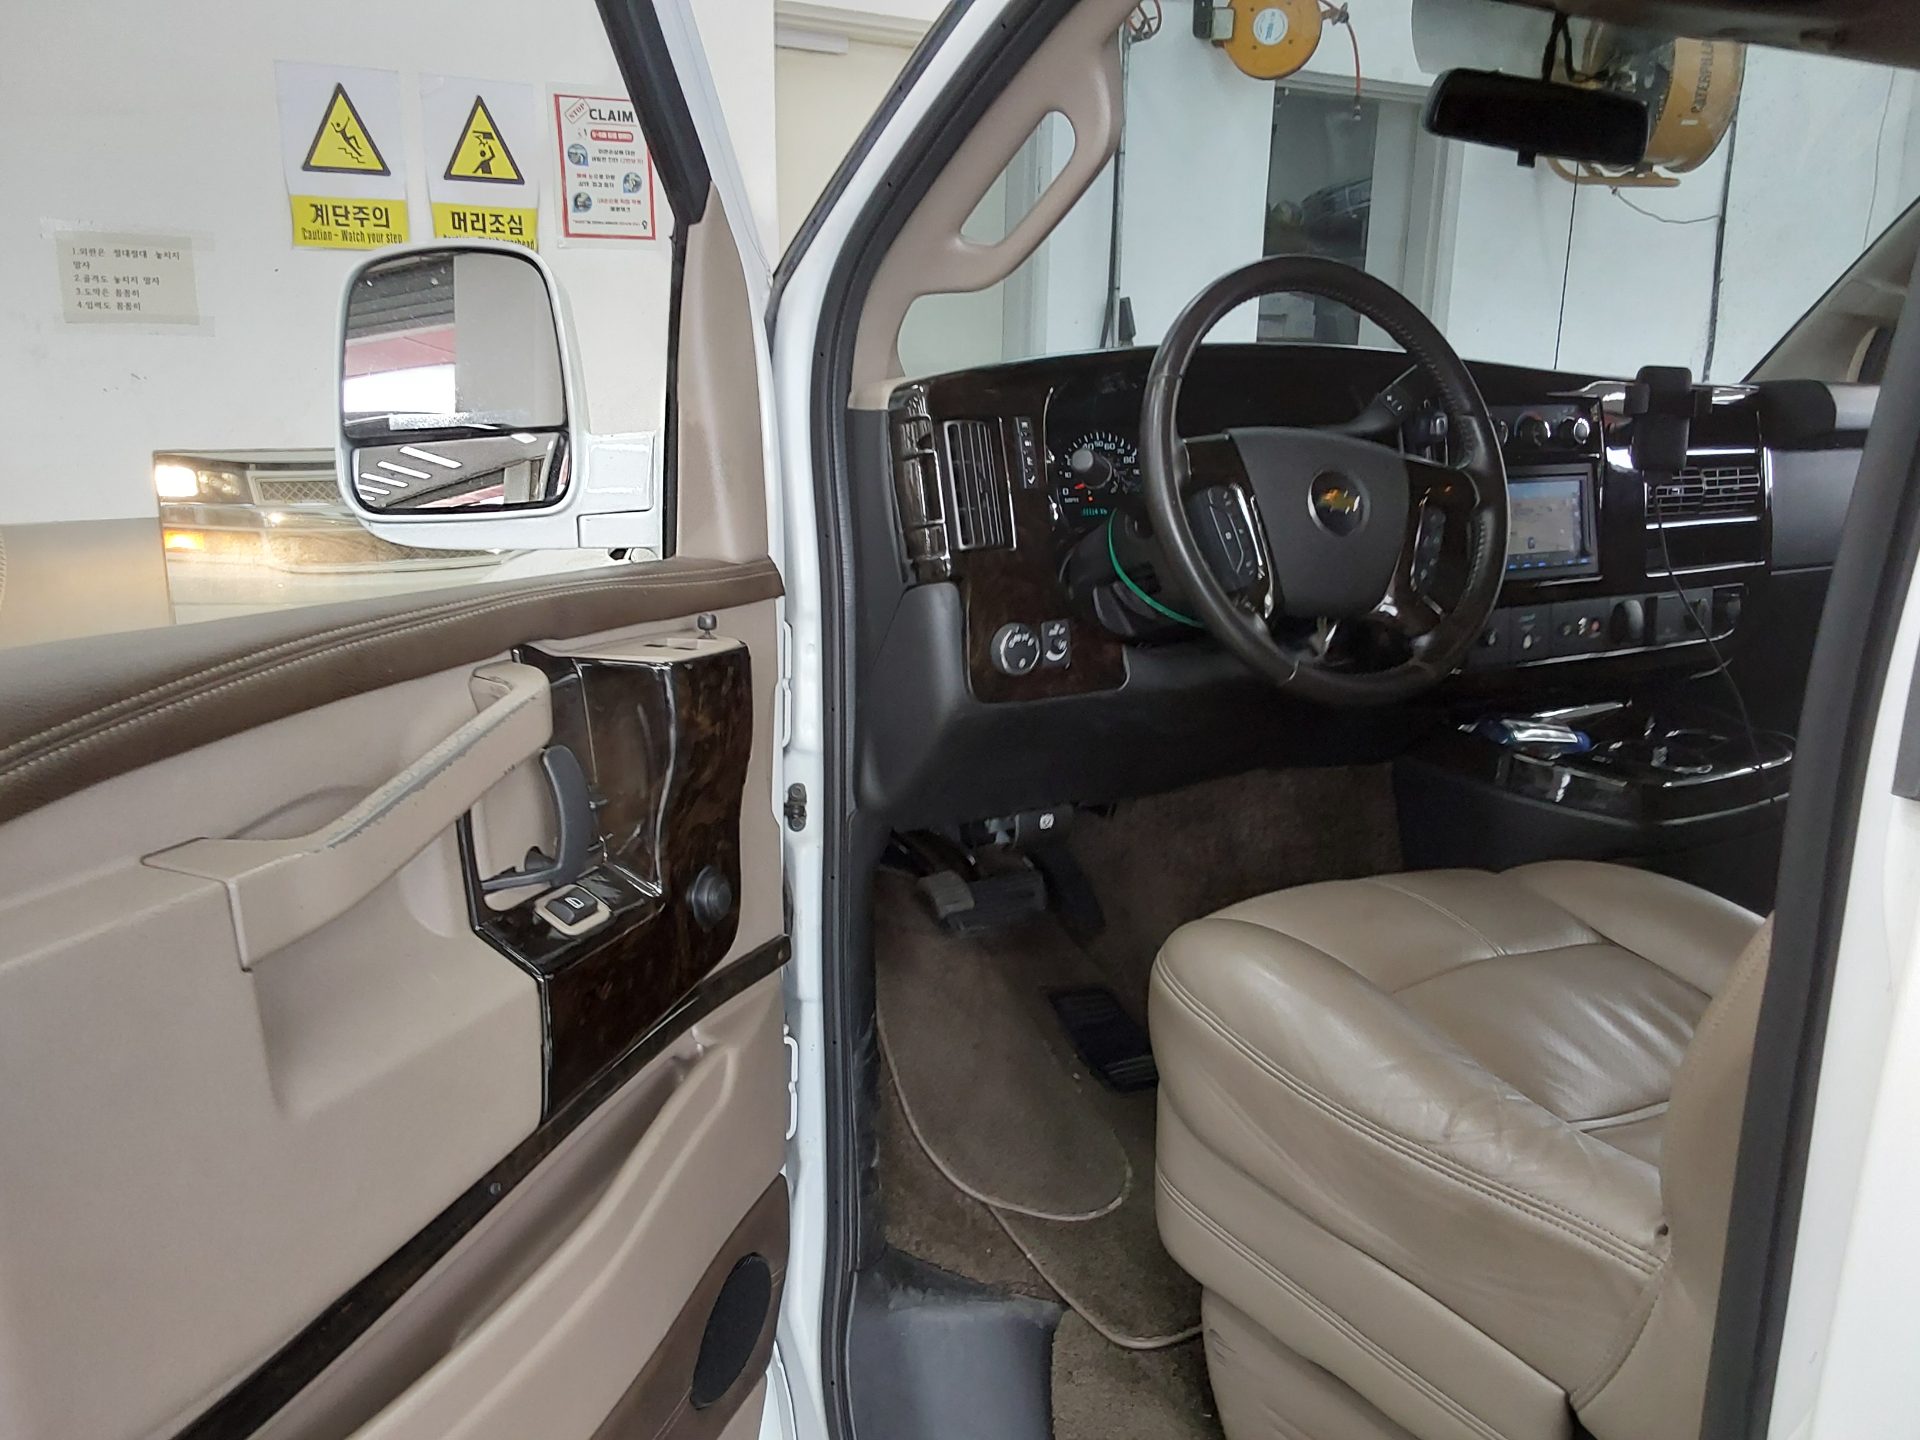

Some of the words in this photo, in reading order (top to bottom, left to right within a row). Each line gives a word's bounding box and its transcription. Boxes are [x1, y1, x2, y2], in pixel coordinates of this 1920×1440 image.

[589, 108, 634, 122] CLAIM
[310, 204, 390, 228] 계단주의
[451, 211, 524, 236] 머리조심
[302, 228, 333, 241] Caution
[341, 229, 366, 243] Watch
[367, 232, 384, 244] your
[385, 233, 403, 244] step
[1104, 442, 1115, 450] 60
[1123, 456, 1135, 464] 80
